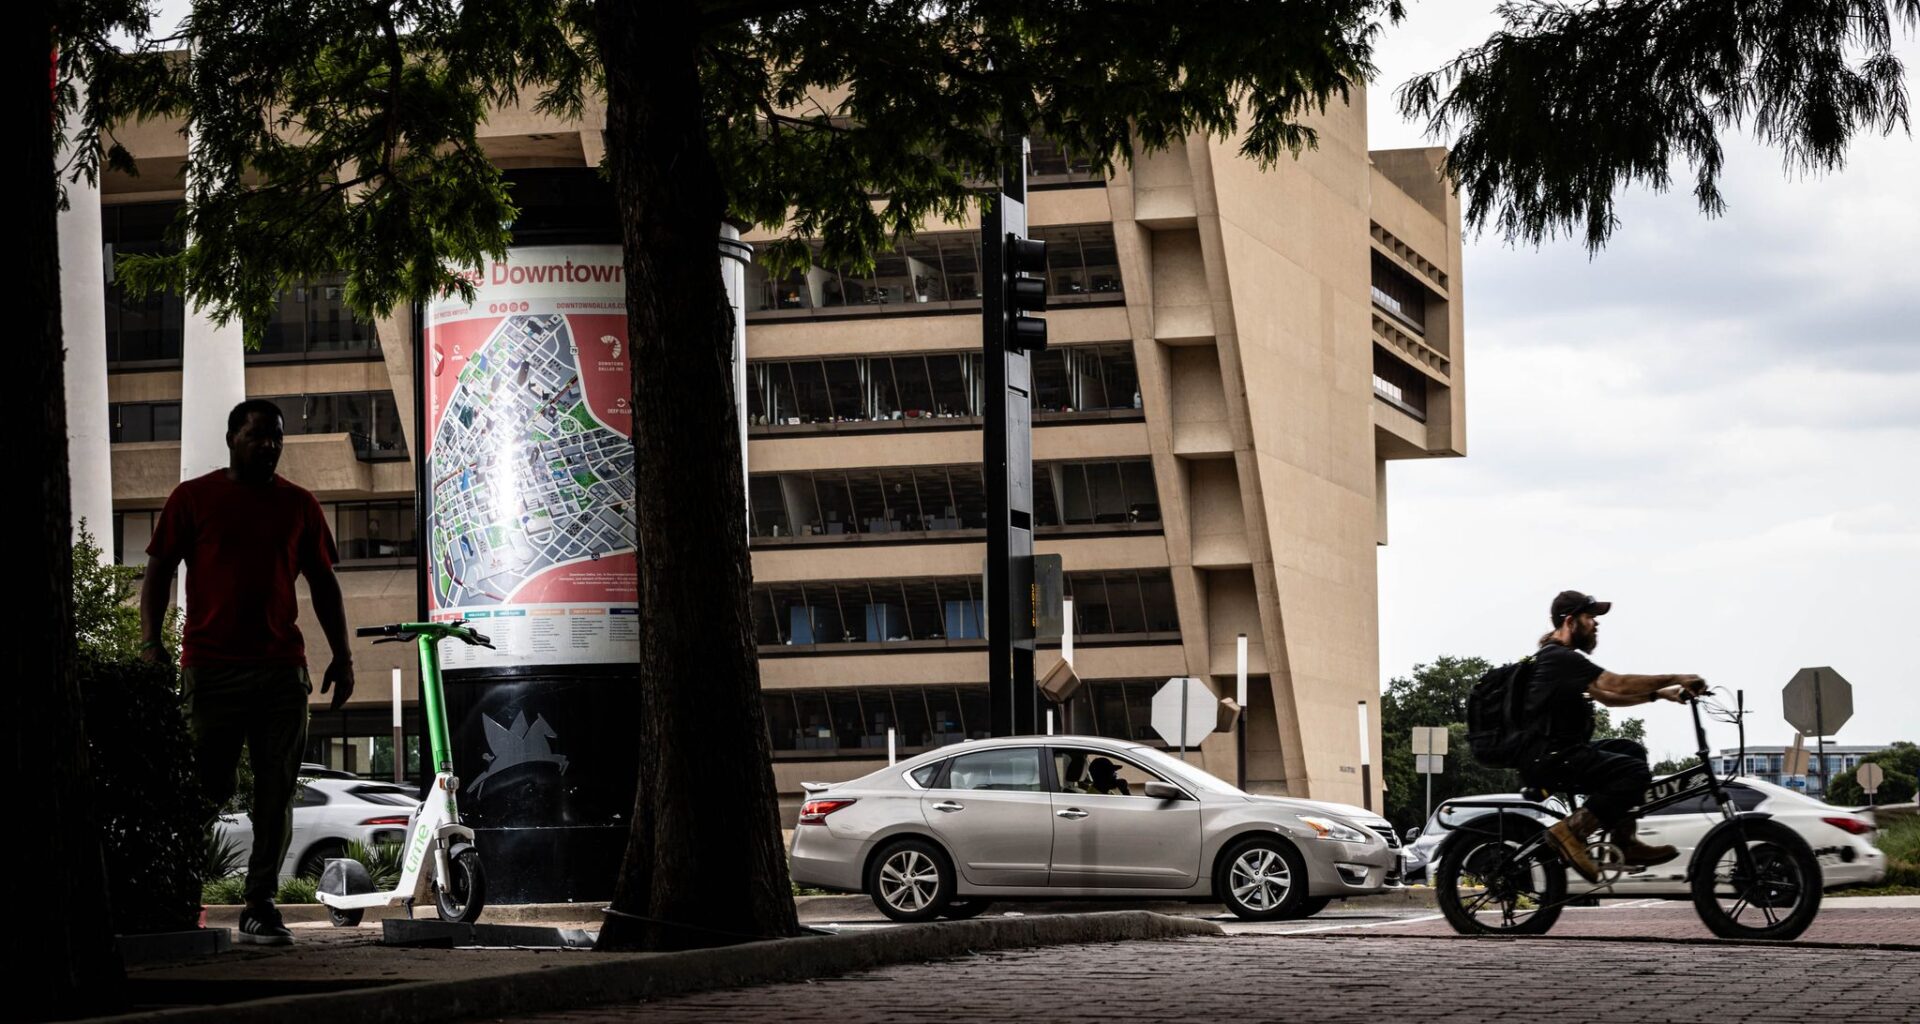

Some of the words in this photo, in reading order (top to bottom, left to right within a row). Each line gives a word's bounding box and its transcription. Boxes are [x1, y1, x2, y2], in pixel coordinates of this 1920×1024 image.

[492, 261, 625, 286] Downtown
[556, 302, 626, 310] DOWNTOWNDALLAS.CO
[406, 824, 429, 873] Lime
